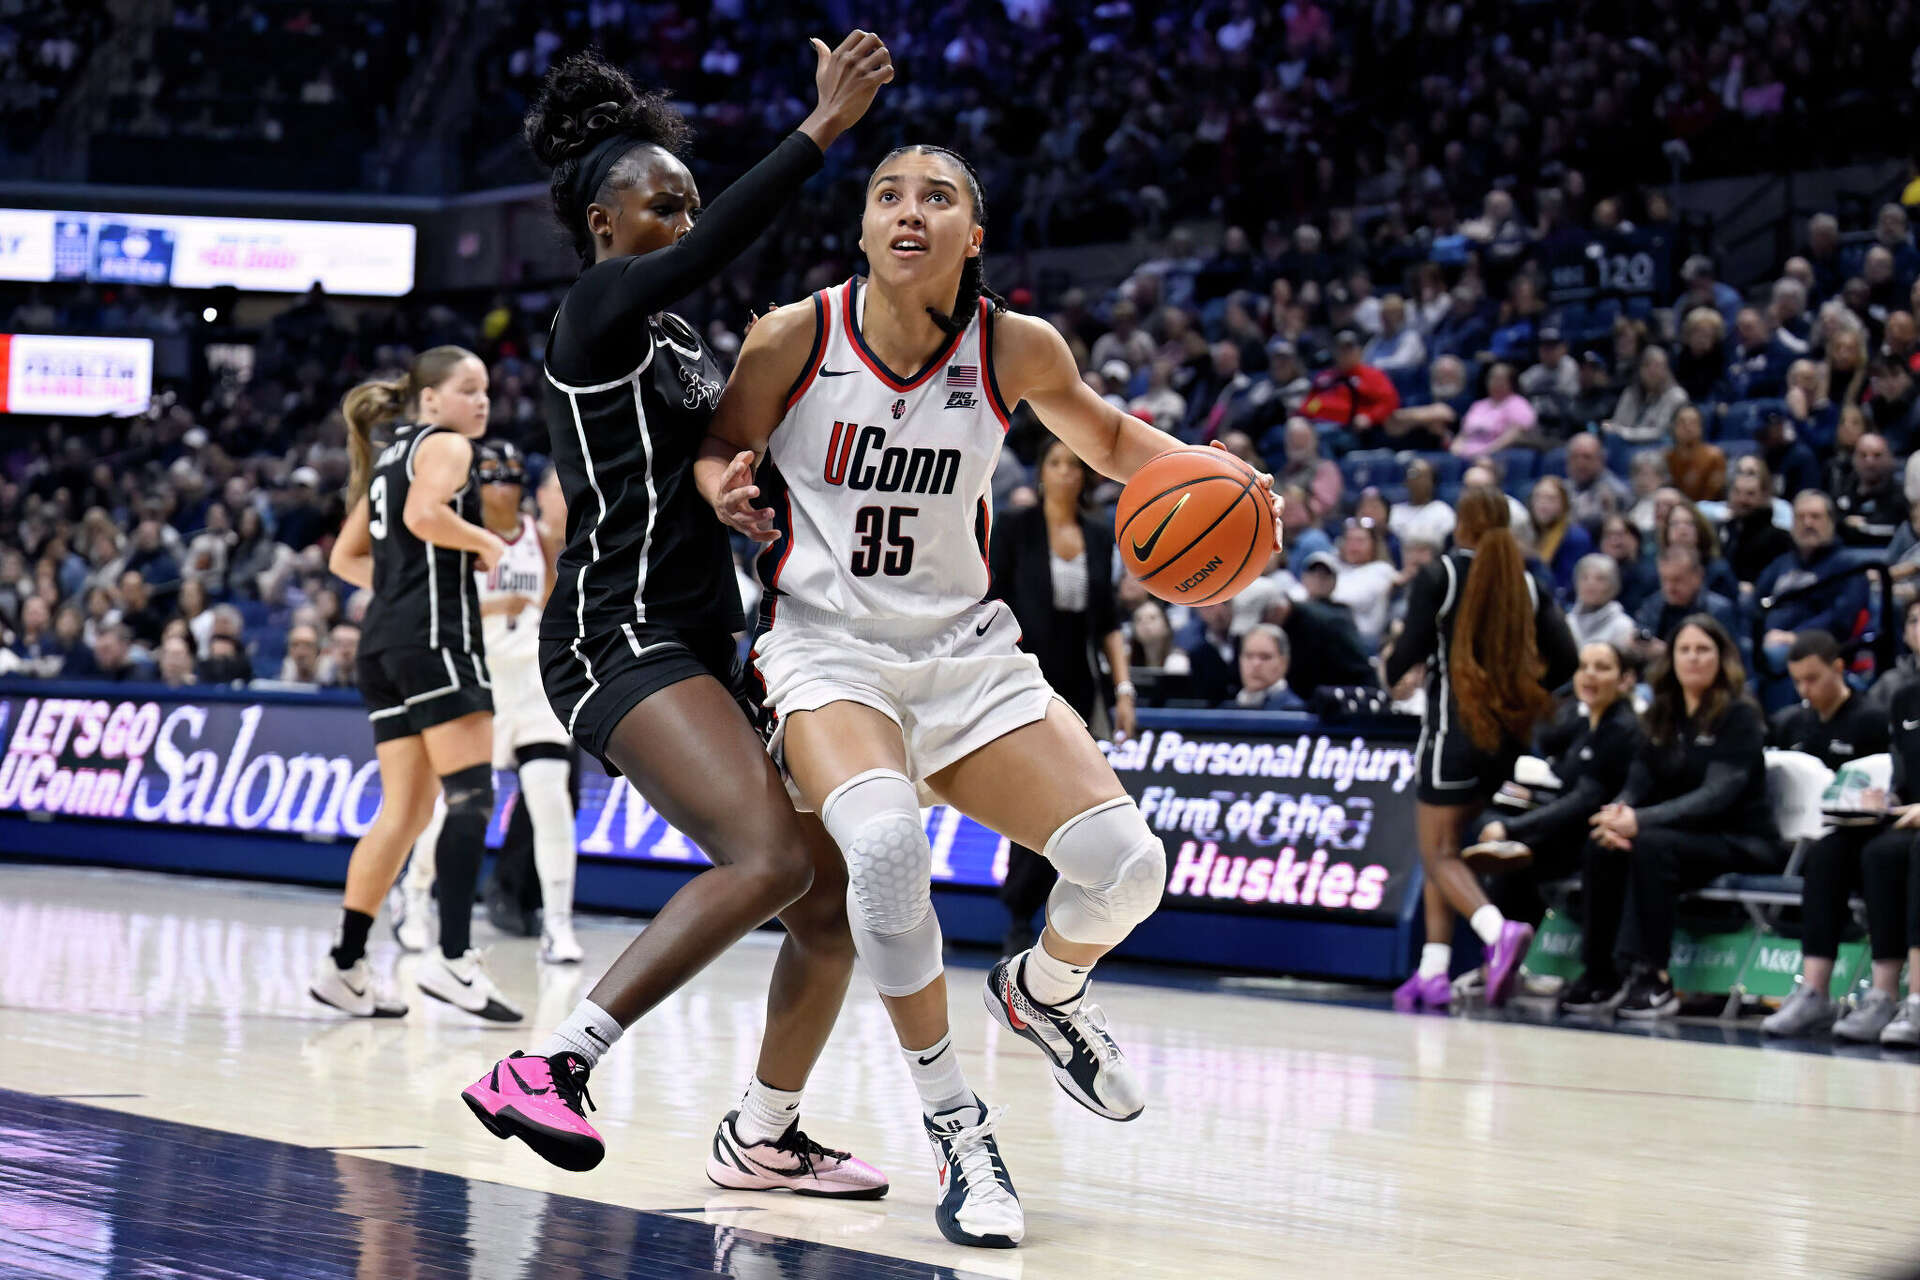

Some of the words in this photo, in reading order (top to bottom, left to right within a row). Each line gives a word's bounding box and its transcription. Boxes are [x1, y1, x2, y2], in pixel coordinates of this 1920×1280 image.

[1597, 251, 1654, 288] 120
[946, 399, 979, 407] EAST
[950, 391, 973, 399] BIG
[824, 421, 961, 495] UConn
[369, 474, 388, 540] 3
[850, 505, 919, 577] 35
[487, 562, 538, 592] UConn
[1175, 556, 1224, 592] UCONN
[101, 701, 160, 759] GO
[0, 750, 143, 817] UConn!
[1152, 730, 1311, 778] Personal
[1308, 736, 1416, 792] Injury
[1138, 786, 1221, 831] Firm
[1277, 793, 1346, 838] the
[1167, 840, 1389, 911] Huskies
